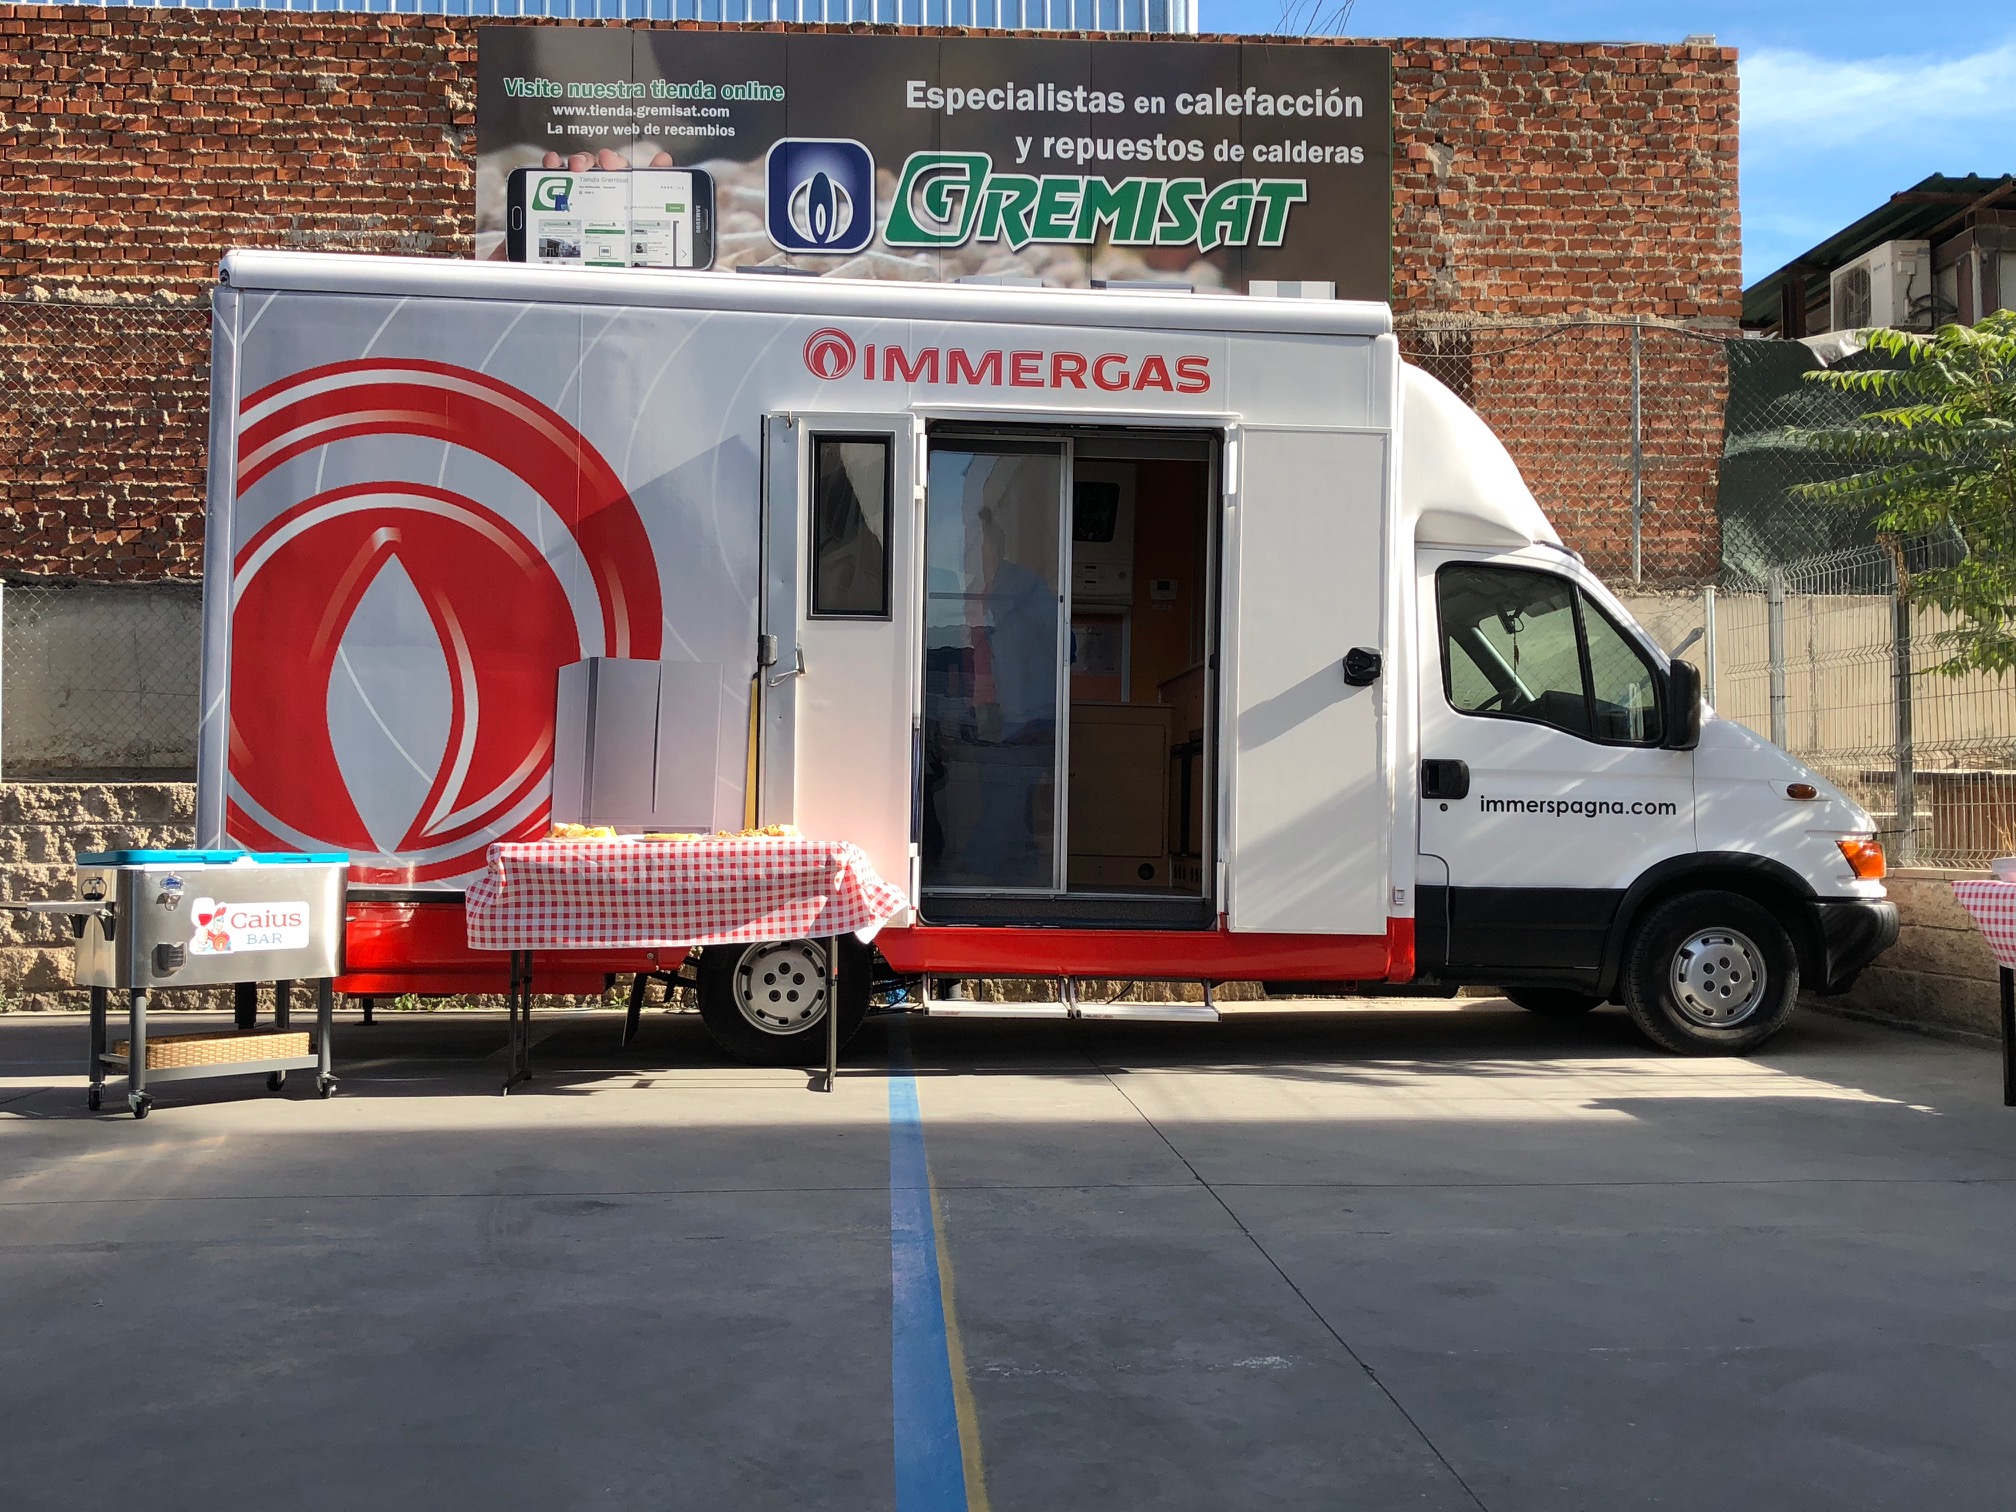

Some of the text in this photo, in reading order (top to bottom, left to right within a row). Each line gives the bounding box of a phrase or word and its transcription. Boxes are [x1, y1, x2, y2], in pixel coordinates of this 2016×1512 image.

[503, 77, 786, 101] Visite nuestra tienda online
[906, 80, 1364, 118] Especialistas en calefacción
[552, 104, 730, 118] www.tienda.gremisat.com
[547, 122, 736, 137] La mayor web de recambios
[1015, 134, 1364, 165] y repuestos de calderas
[601, 176, 629, 184] Gremisat
[884, 151, 1306, 253] GREMISAT
[864, 343, 1211, 393] IMMERGAS
[1480, 794, 1677, 818] immerspagna.com
[230, 910, 302, 929] Caius
[246, 933, 282, 944] BAR
